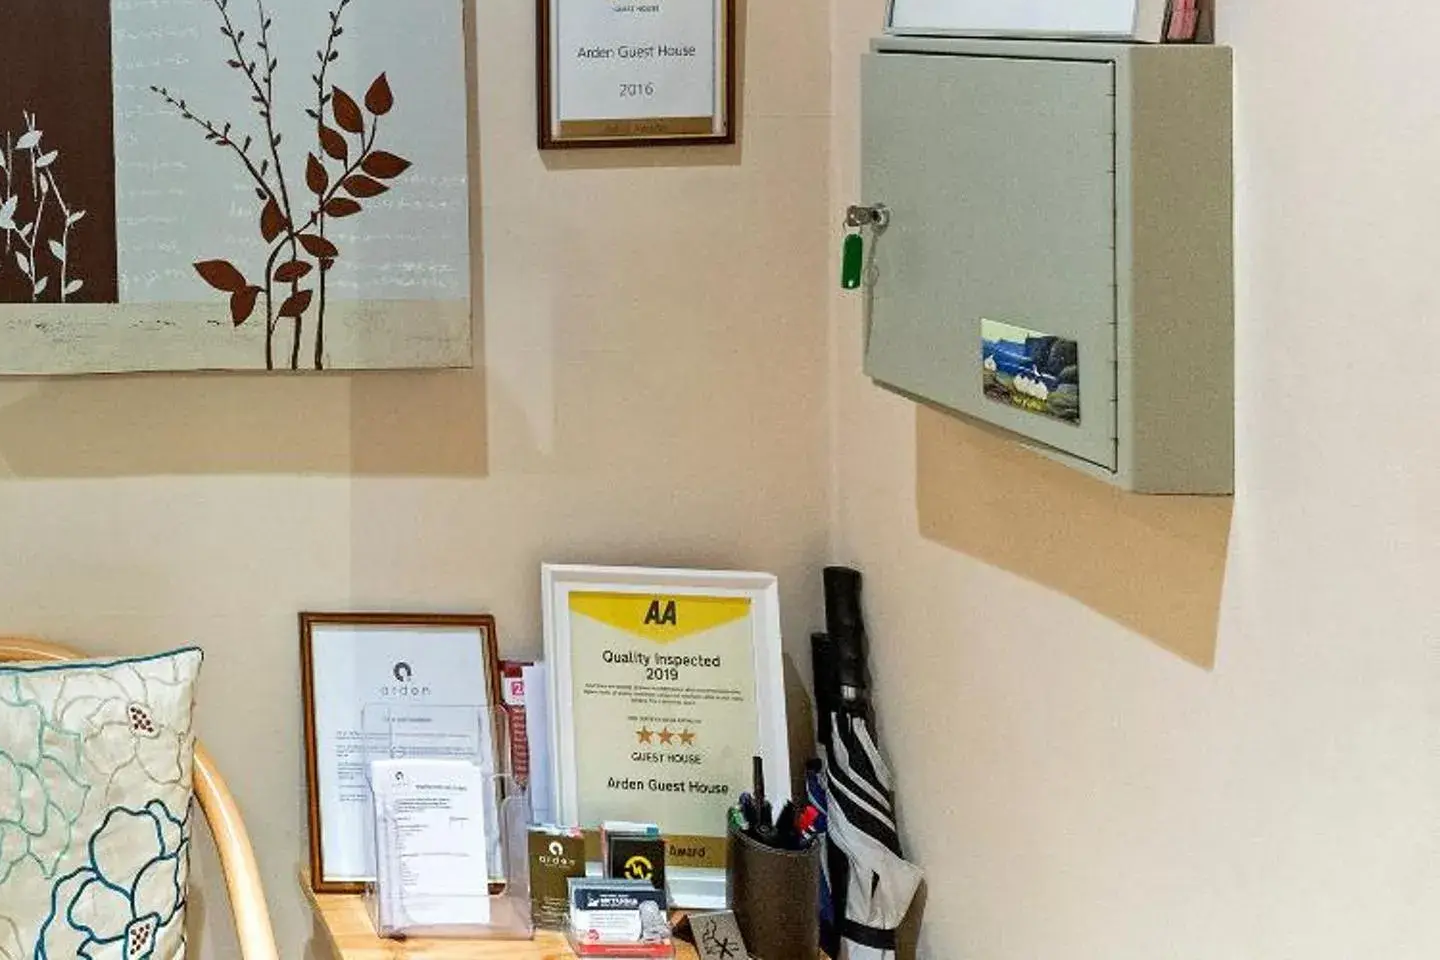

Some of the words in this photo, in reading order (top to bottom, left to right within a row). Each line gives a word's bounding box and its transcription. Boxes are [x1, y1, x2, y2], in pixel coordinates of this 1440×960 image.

[577, 46, 613, 58] Arden
[618, 46, 654, 58] Guest
[658, 45, 696, 57] House
[619, 82, 654, 97] 2016
[644, 600, 677, 625] AA
[602, 650, 650, 667] Quality
[655, 652, 721, 669] Inspected
[646, 667, 679, 681] 2019
[631, 752, 663, 764] GUEST
[668, 753, 701, 765] HOUSE
[608, 777, 644, 790] Arden
[648, 778, 686, 792] Guest
[689, 781, 729, 794] House
[669, 844, 706, 857] Award
